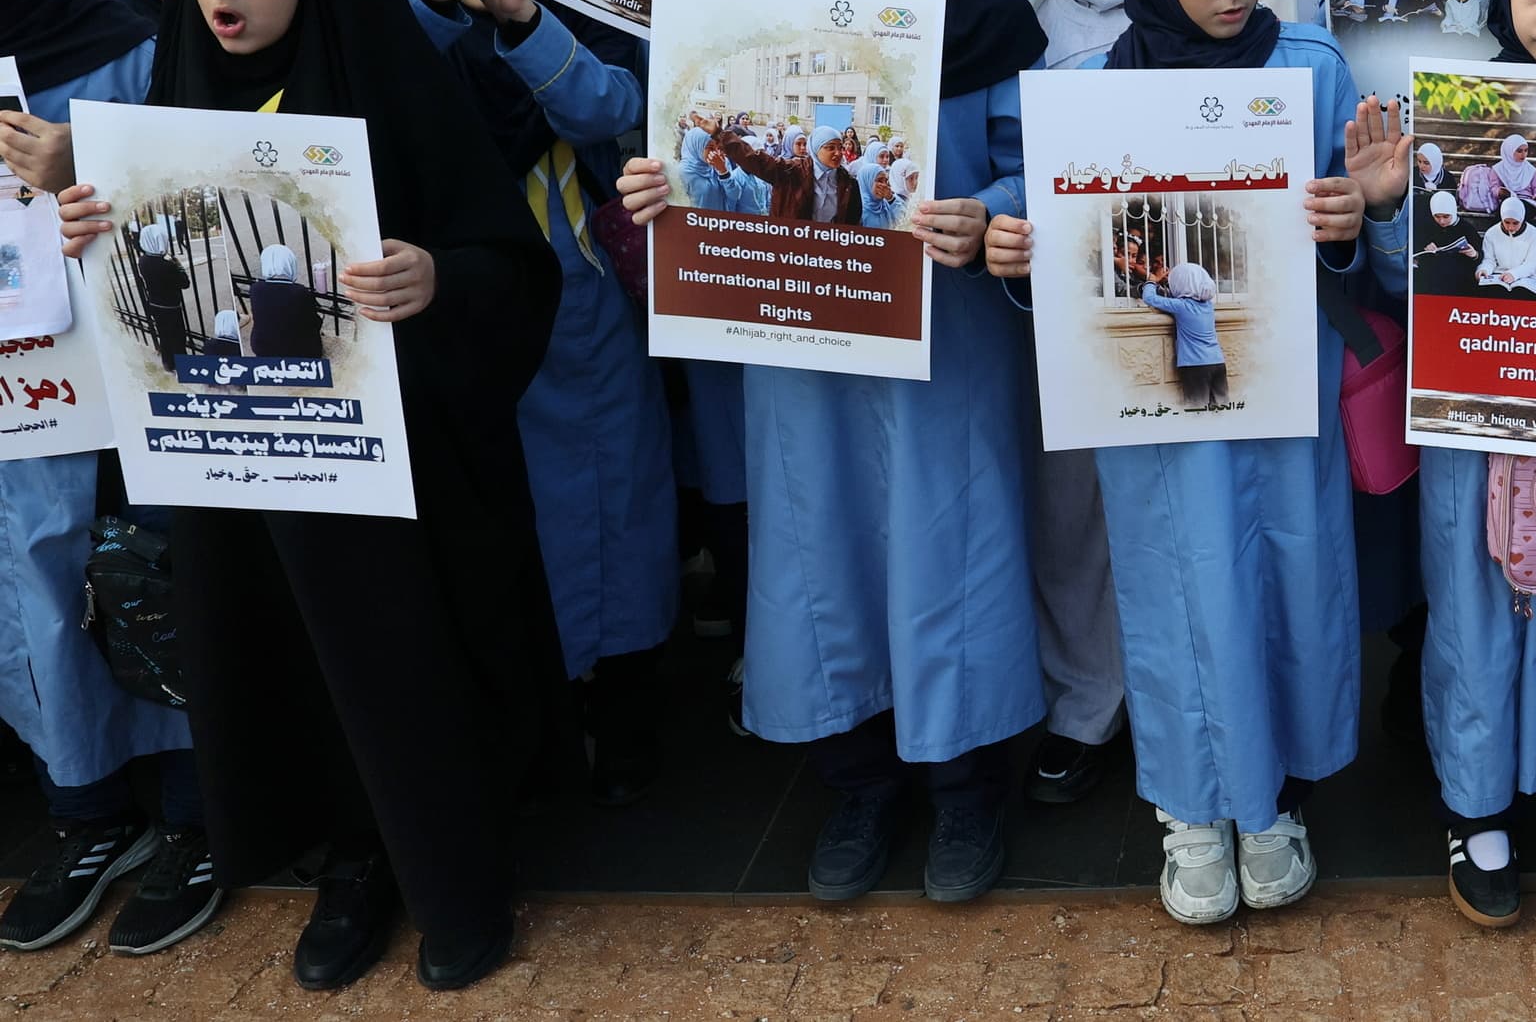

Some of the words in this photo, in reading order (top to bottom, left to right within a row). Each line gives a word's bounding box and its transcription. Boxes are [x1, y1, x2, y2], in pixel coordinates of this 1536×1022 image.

[1058, 162, 1113, 191] وخيار
[1184, 157, 1286, 187] الحجاب
[685, 211, 790, 243] Suppression
[793, 224, 810, 239] of
[813, 226, 885, 248] religious
[698, 241, 776, 265] freedoms
[779, 251, 843, 271] violates
[846, 257, 872, 274] the
[678, 268, 780, 292] International
[785, 275, 811, 295] Bill
[815, 281, 831, 297] of
[835, 284, 893, 304] Human
[759, 303, 813, 324] Rights
[726, 325, 852, 349] #Alhijab_right_and_choice
[215, 359, 248, 382] حق
[253, 359, 324, 382] التعليم
[17, 377, 77, 411] رمز
[252, 399, 355, 418] الحجاب
[149, 431, 203, 453] ظلم.
[208, 432, 269, 457] بينهما
